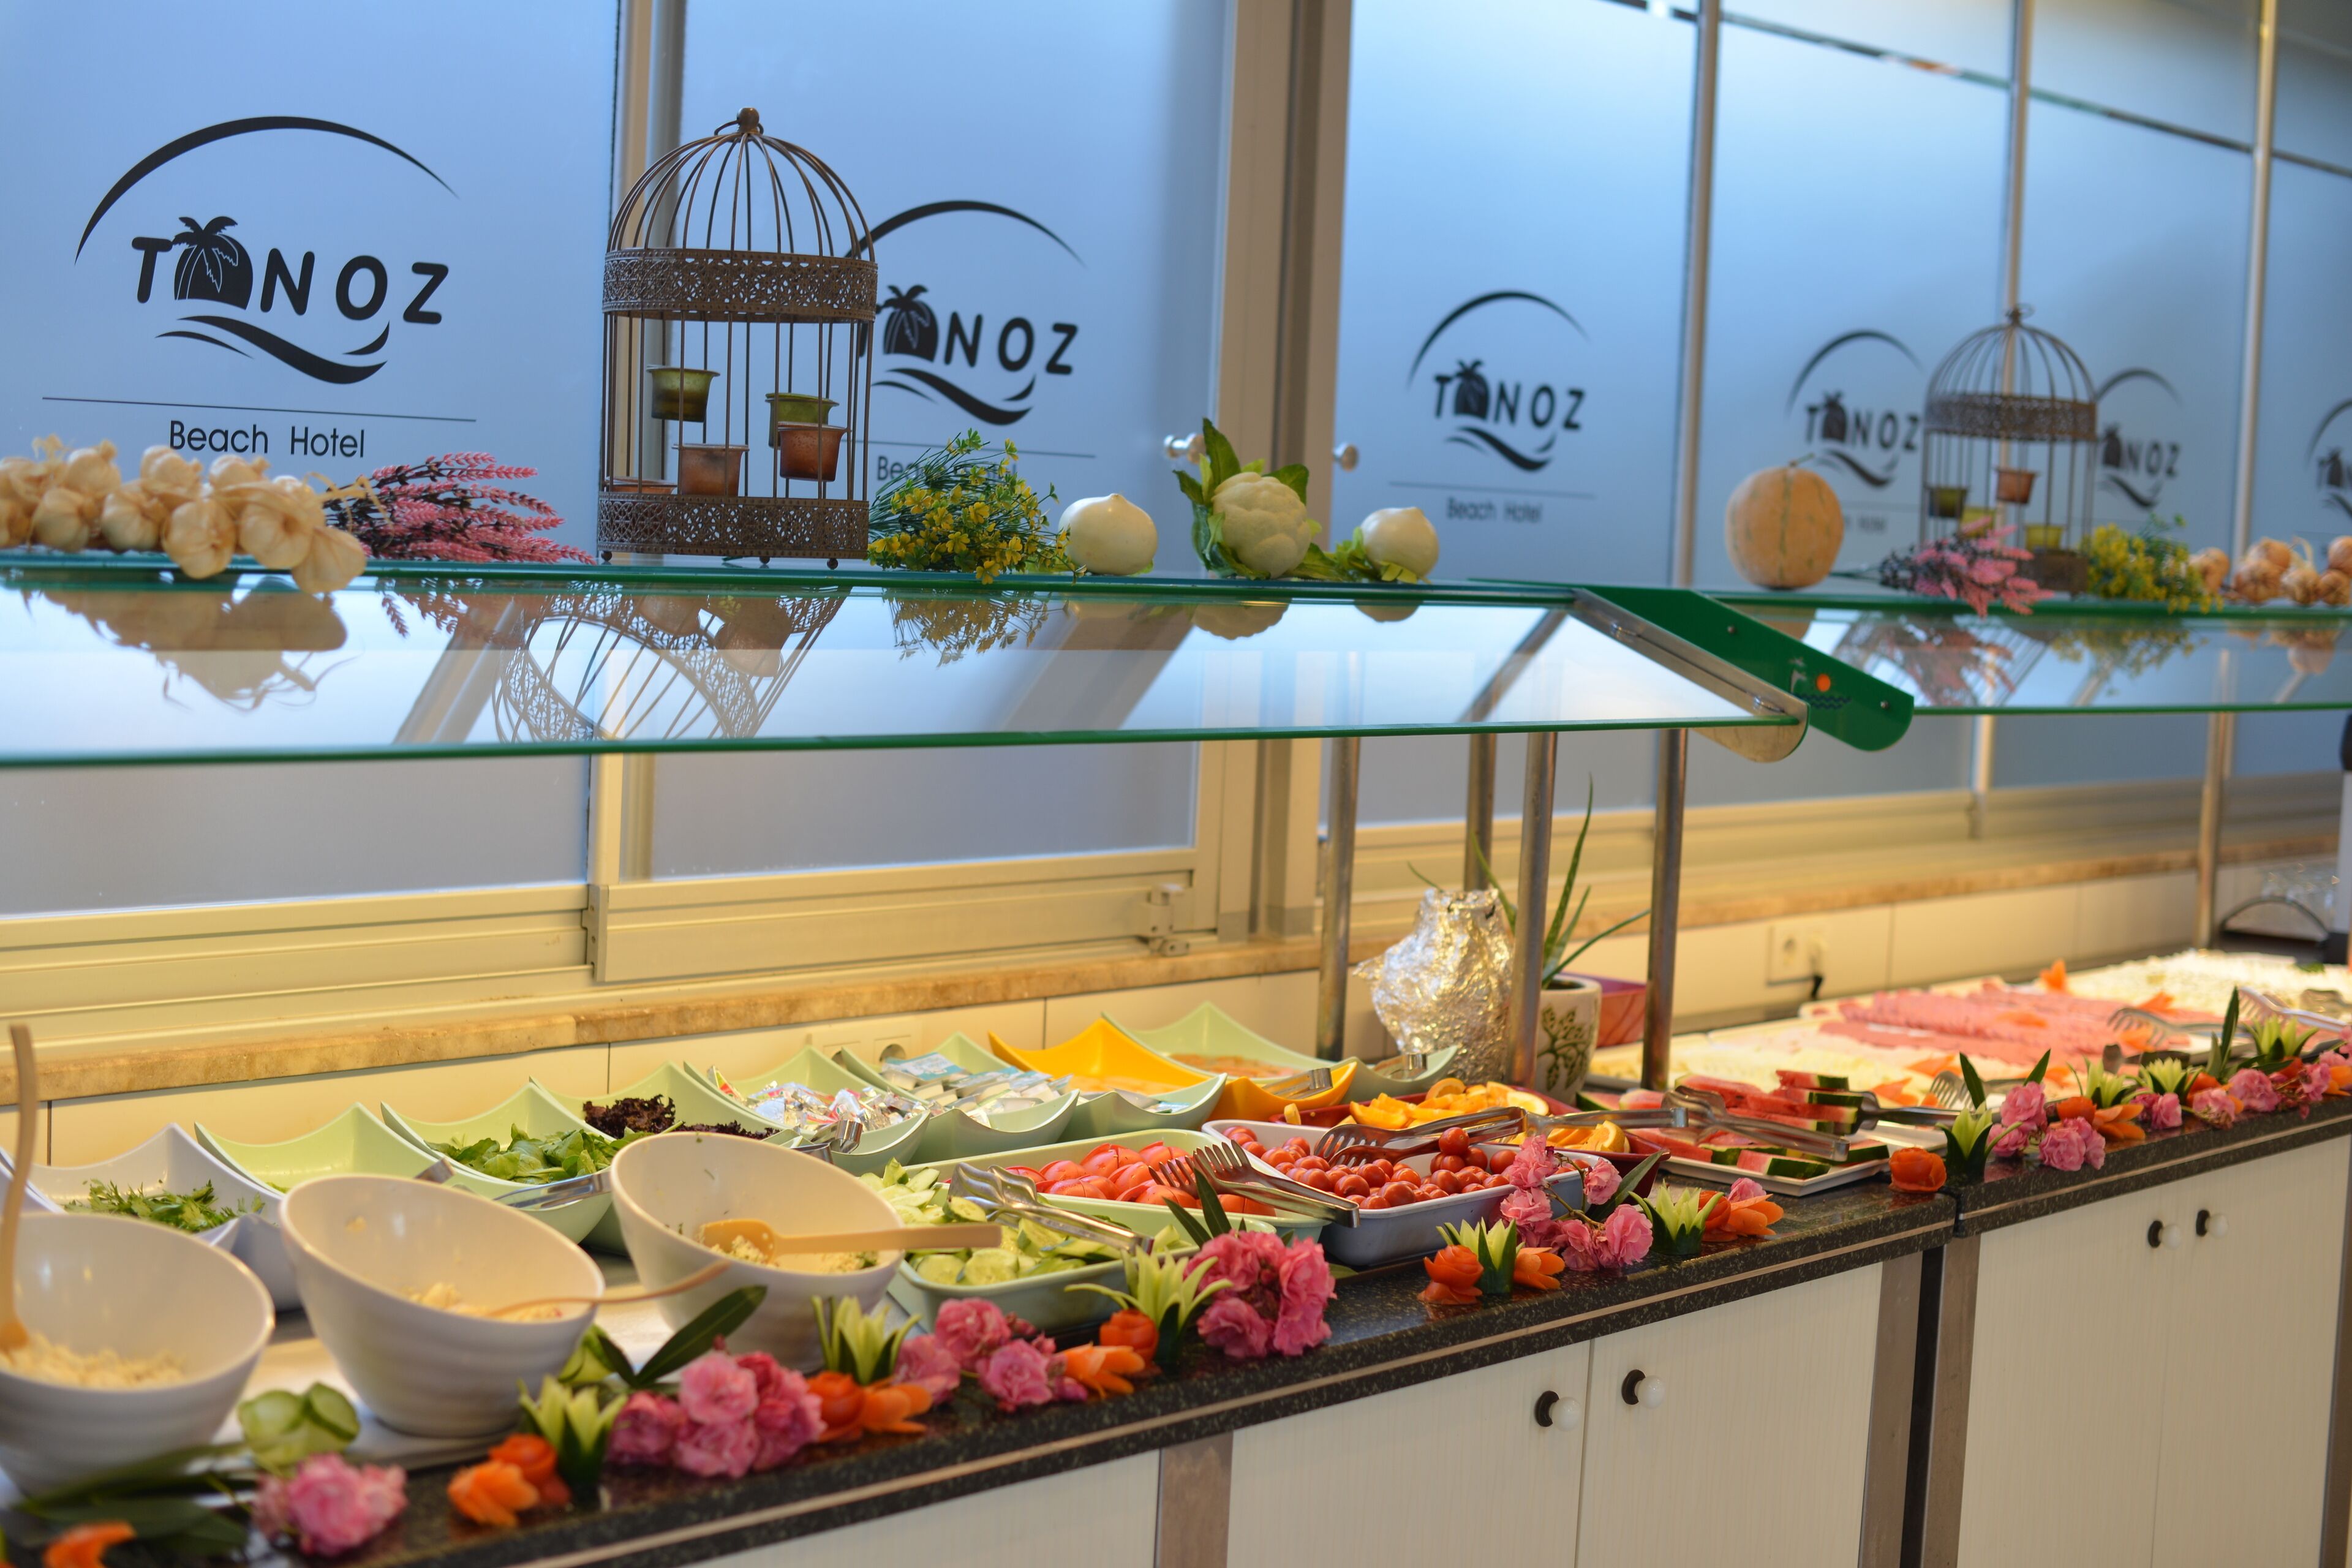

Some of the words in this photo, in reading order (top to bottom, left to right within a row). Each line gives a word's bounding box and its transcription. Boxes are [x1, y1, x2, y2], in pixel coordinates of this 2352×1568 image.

[170, 420, 268, 454] Beach
[291, 426, 365, 458] Hotel
[1447, 497, 1496, 521] Beach
[1504, 501, 1543, 522] Hotel
